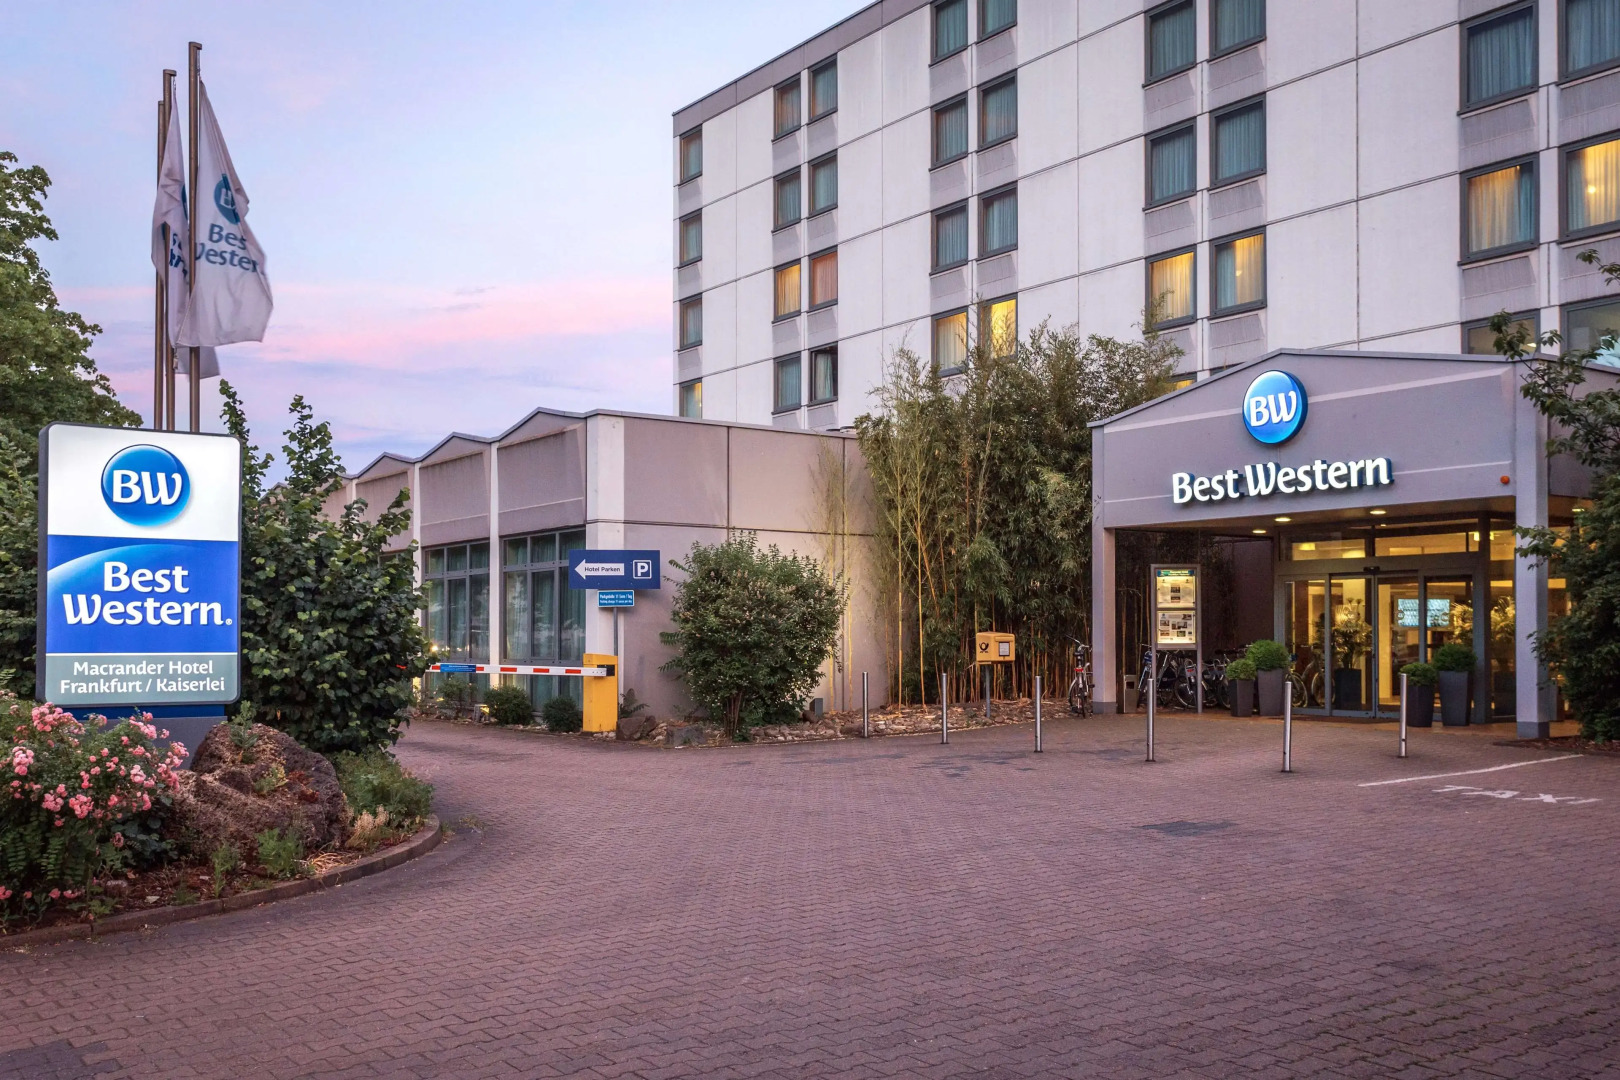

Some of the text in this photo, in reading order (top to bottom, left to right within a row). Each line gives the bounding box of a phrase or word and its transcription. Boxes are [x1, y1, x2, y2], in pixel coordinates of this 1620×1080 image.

[208, 223, 248, 251] Bes
[195, 242, 260, 273] ester
[1250, 390, 1297, 427] BW
[112, 469, 183, 506] BW
[1172, 457, 1392, 504] Best Western
[103, 561, 190, 594] Best
[637, 562, 649, 577] P
[73, 660, 213, 676] Macrander Hotel
[60, 677, 225, 694] Frankfurt / Kaiserlei
[1431, 784, 1603, 805] TAXI
